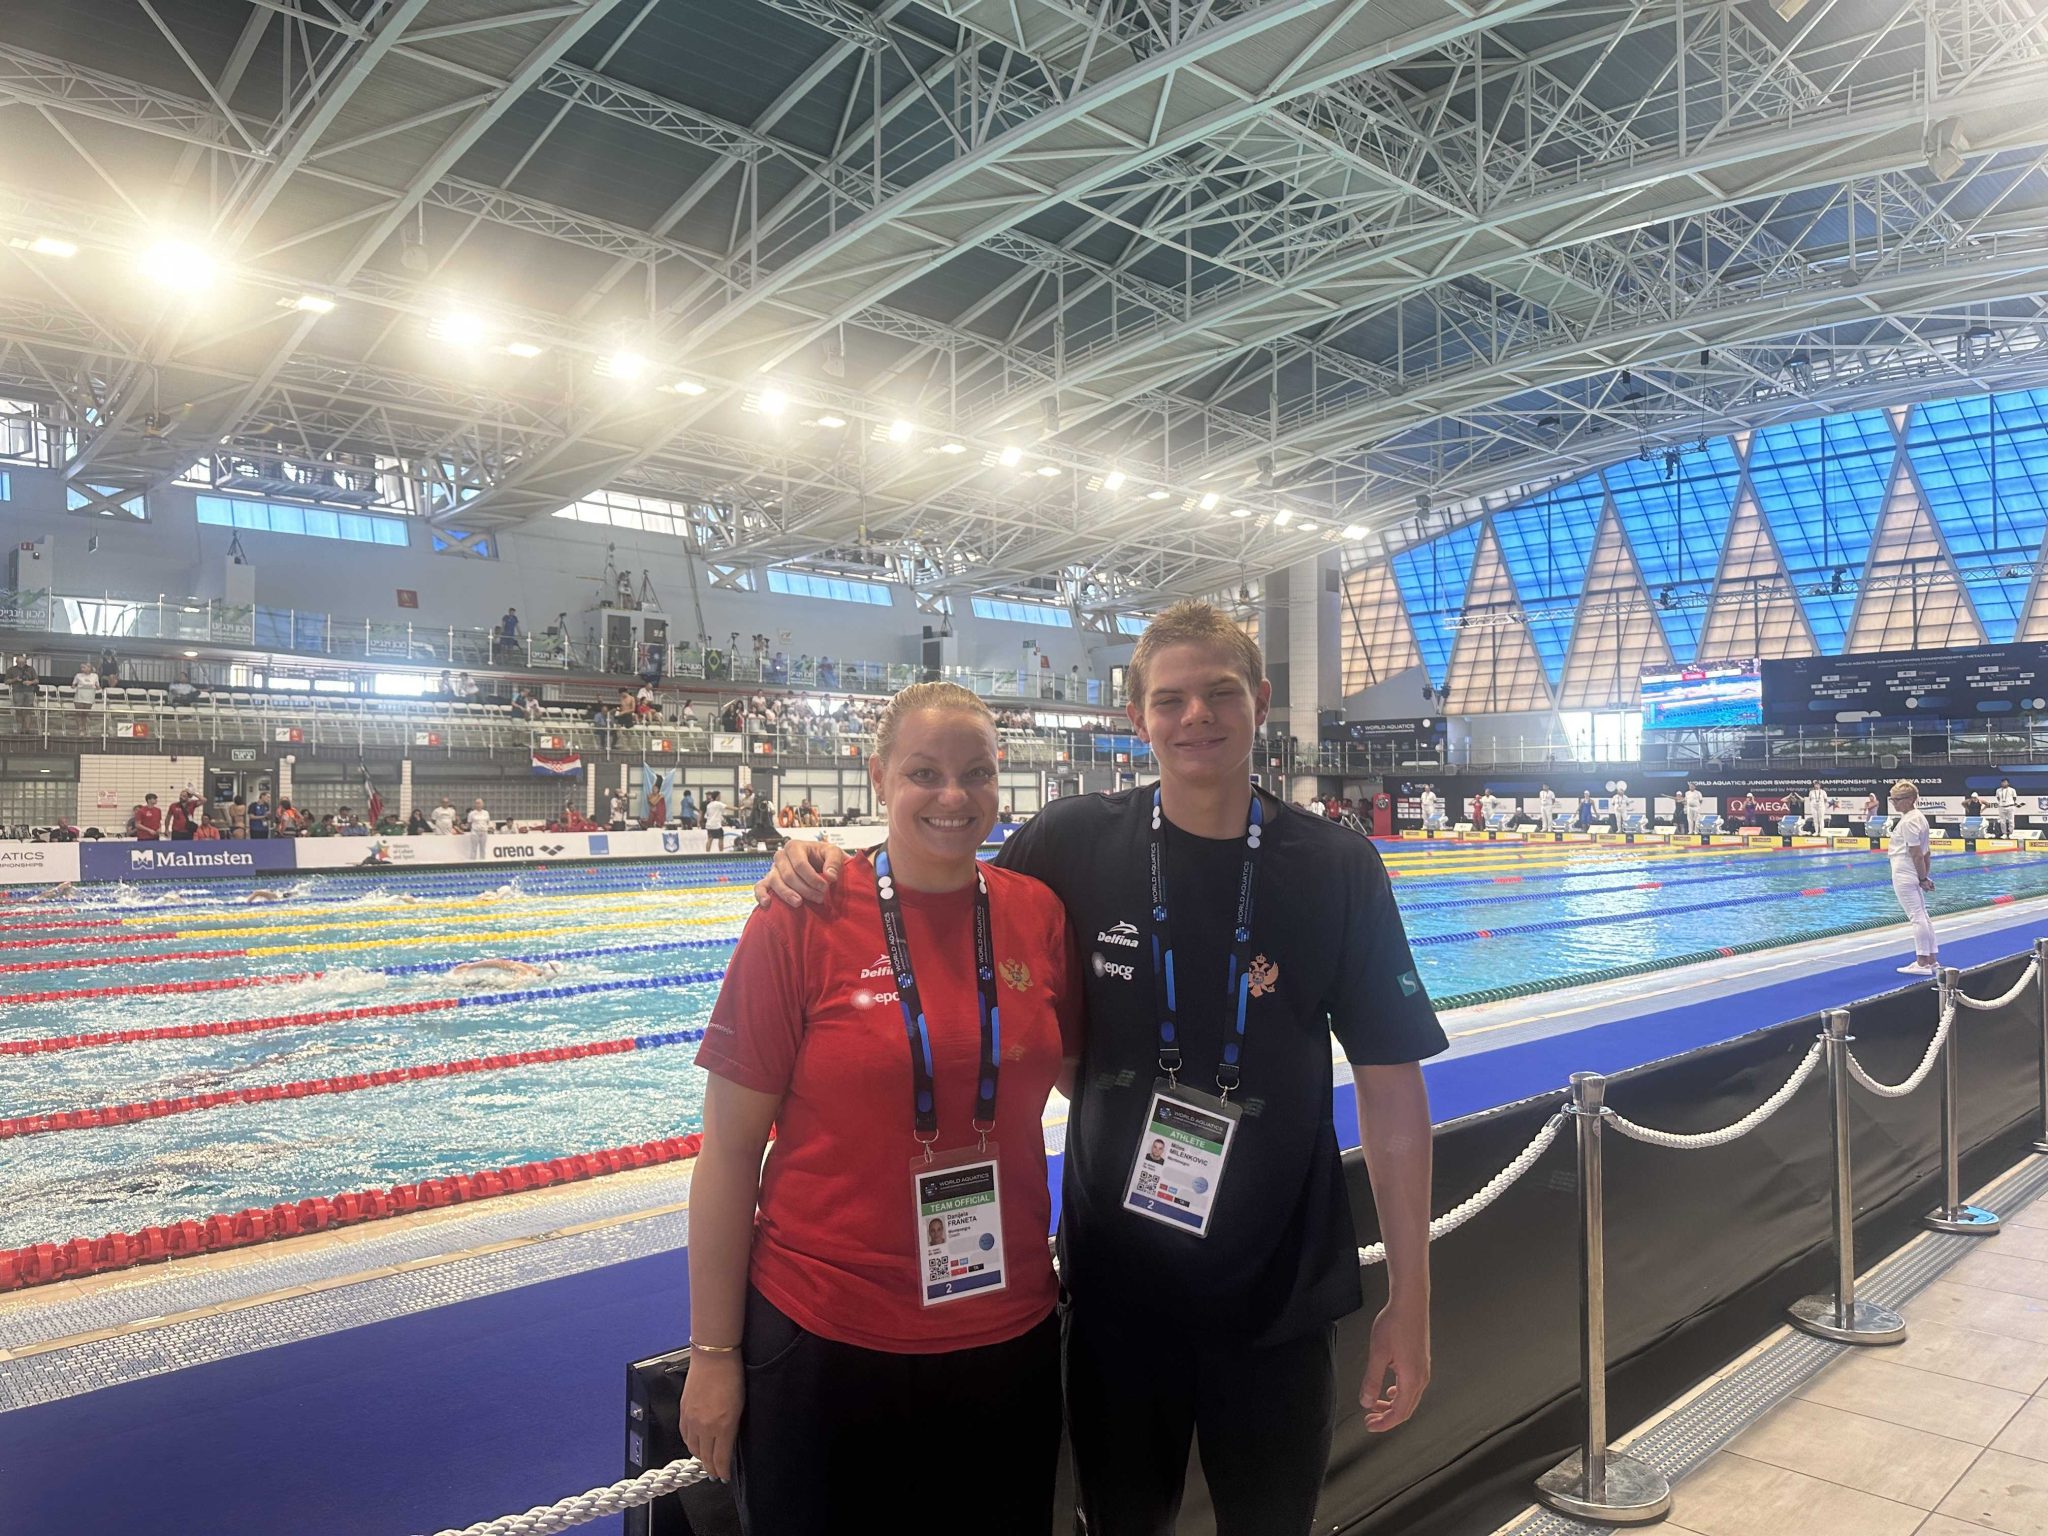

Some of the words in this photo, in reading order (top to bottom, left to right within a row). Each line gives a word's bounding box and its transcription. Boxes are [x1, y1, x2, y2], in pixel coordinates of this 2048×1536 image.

[1755, 801, 1790, 811] MEGA
[493, 845, 535, 858] arena
[156, 852, 253, 867] Malmsten
[1097, 931, 1139, 948] Delfina
[860, 966, 894, 979] Delfi
[1104, 961, 1134, 981] epcg
[875, 991, 900, 1006] epc
[1170, 1131, 1206, 1149] ATHLETE
[930, 1201, 953, 1213] TEAM
[954, 1193, 991, 1208] OFFICIAL
[1146, 1200, 1155, 1210] 2
[947, 1215, 977, 1228] FRANETA
[946, 1282, 953, 1293] 2
